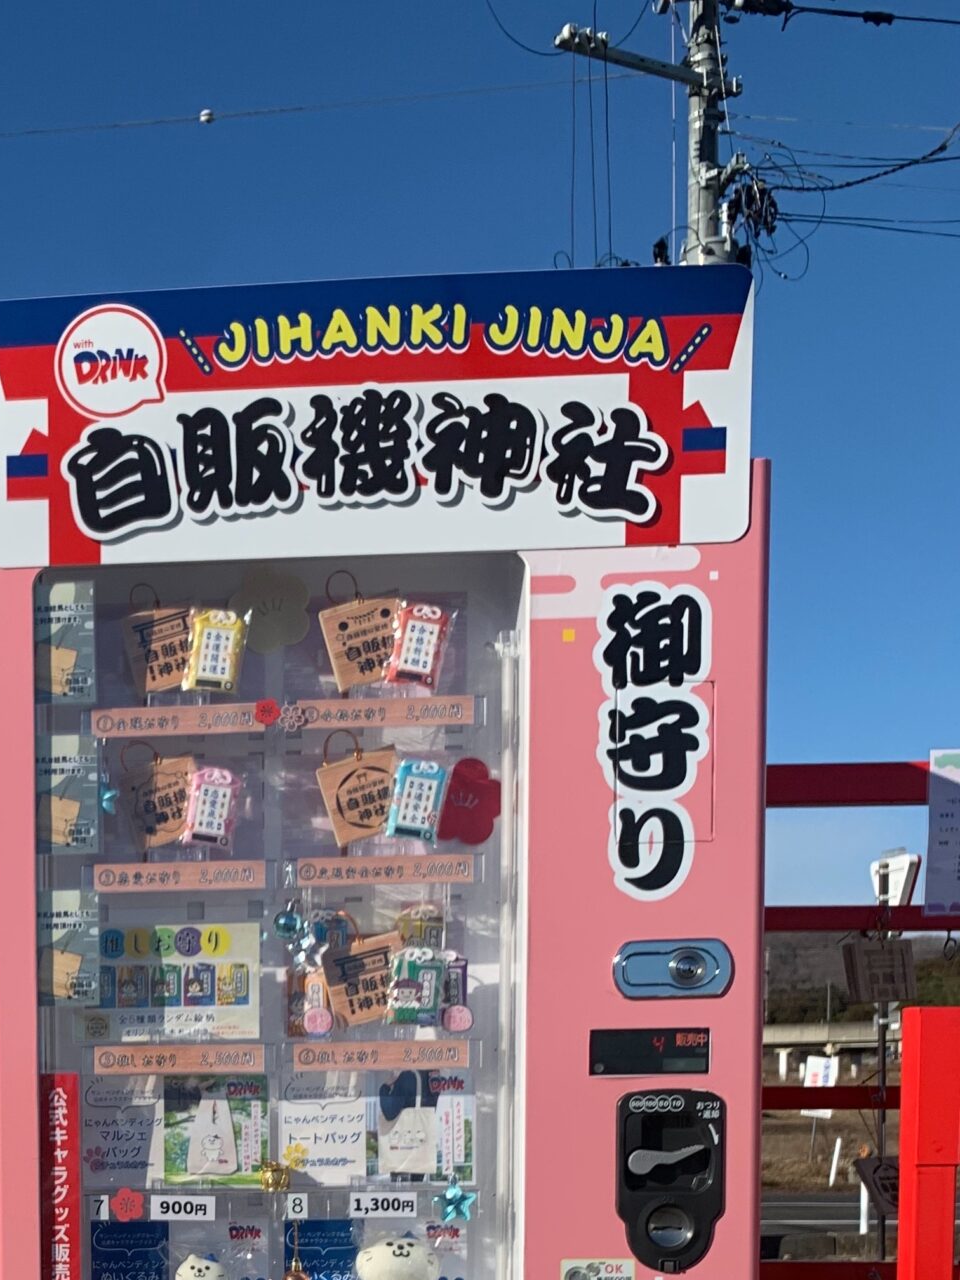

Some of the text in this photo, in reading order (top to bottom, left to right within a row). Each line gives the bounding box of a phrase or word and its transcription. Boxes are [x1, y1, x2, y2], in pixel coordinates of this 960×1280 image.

[216, 303, 670, 367] JIHANKI JINJA
[73, 338, 94, 349] with
[72, 351, 149, 386] DRINK
[68, 388, 660, 532] 自販機神社
[603, 591, 703, 890] 御守り
[676, 1033, 708, 1047] 販売中
[696, 1101, 720, 1110] おつり
[100, 1130, 147, 1141] マルシェ
[289, 1131, 361, 1144] トートバッグ
[106, 1147, 142, 1158] バッグ
[94, 1199, 103, 1215] 7
[160, 1201, 206, 1215] 900円
[292, 1198, 303, 1213] 8
[354, 1198, 414, 1213] 1,300円
[605, 1264, 623, 1273] OK
